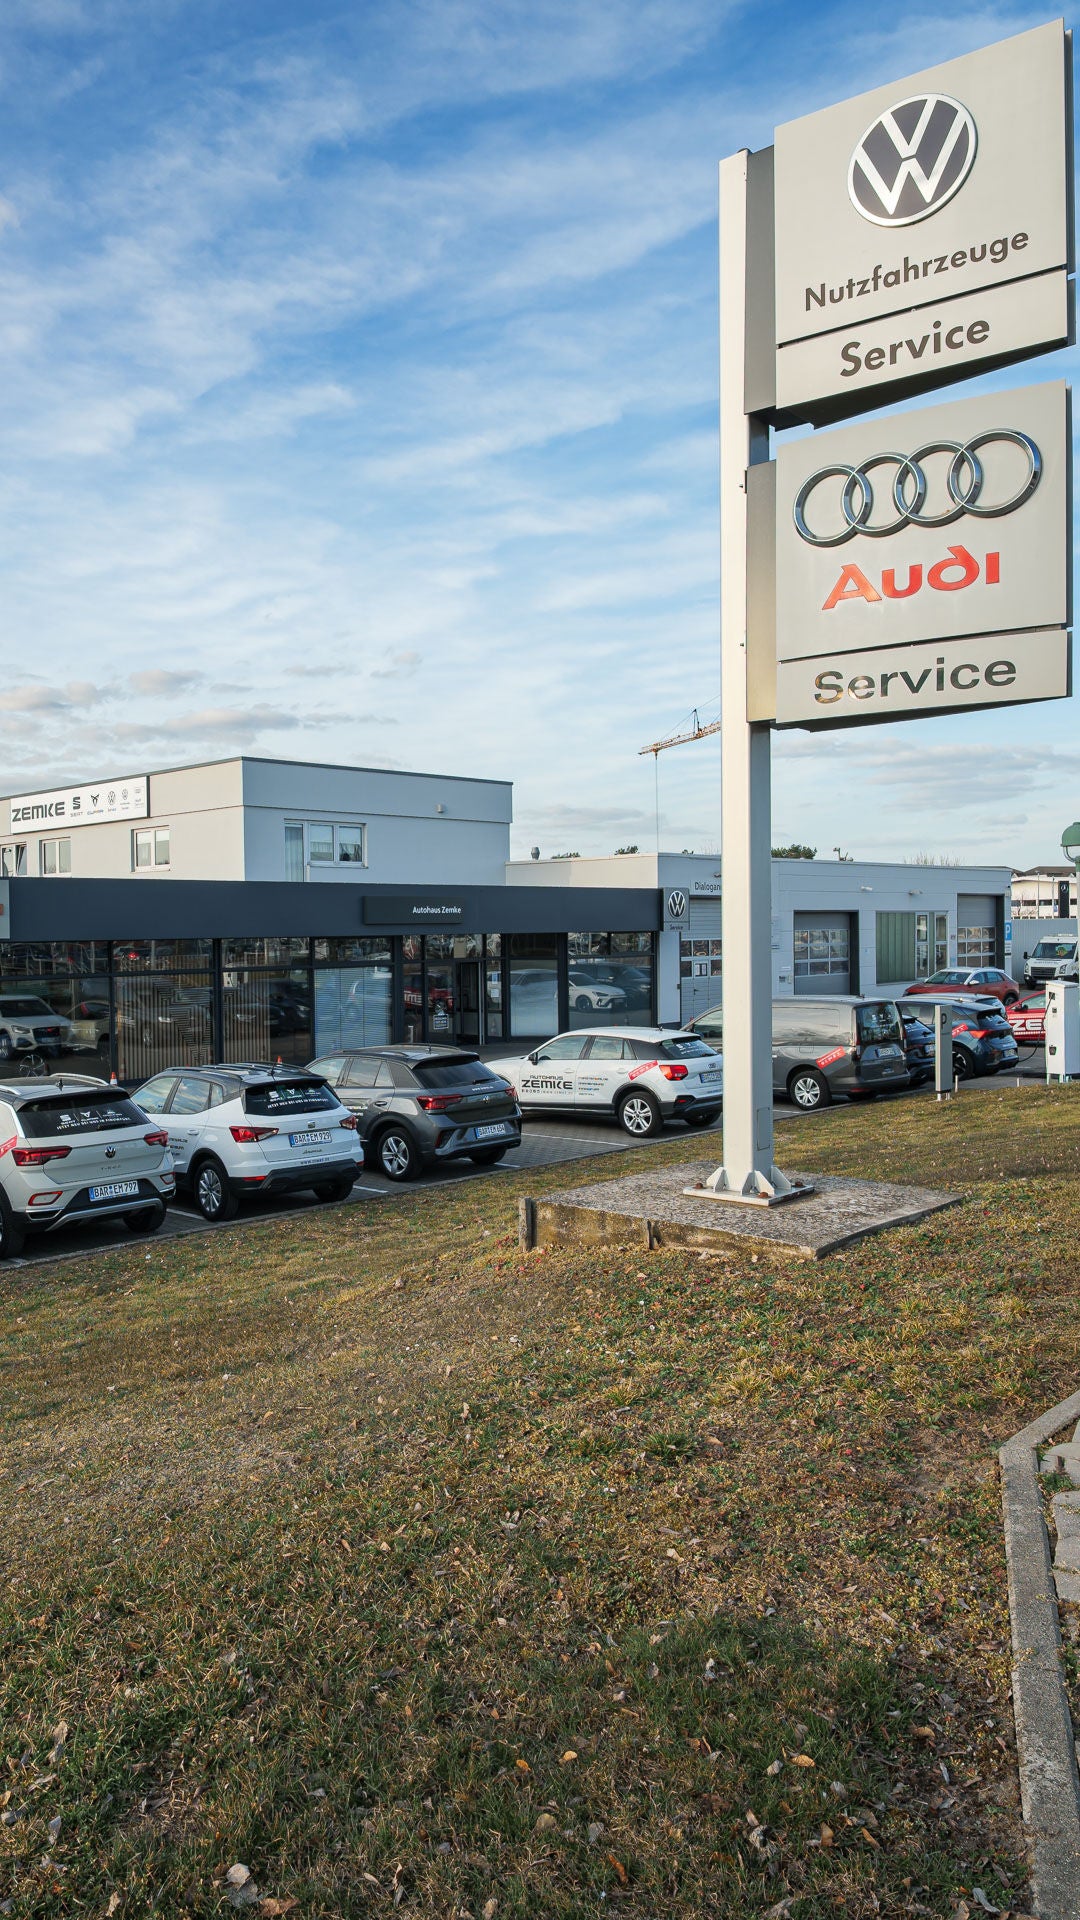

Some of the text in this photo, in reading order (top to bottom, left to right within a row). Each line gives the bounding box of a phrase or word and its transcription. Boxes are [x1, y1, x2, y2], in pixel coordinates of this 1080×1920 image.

[805, 232, 1029, 311] Nutzfahrzeuge
[840, 319, 990, 378] Service
[822, 545, 1000, 610] Audi
[814, 657, 1016, 704] Service
[12, 801, 65, 822] ZEMKE
[412, 905, 462, 914] Autohaus Zemke
[1008, 1018, 1045, 1032] ZE
[521, 1079, 573, 1090] ZEMKE
[294, 1131, 330, 1144] BAR EM 929
[94, 1181, 137, 1198] BAR EM 797
